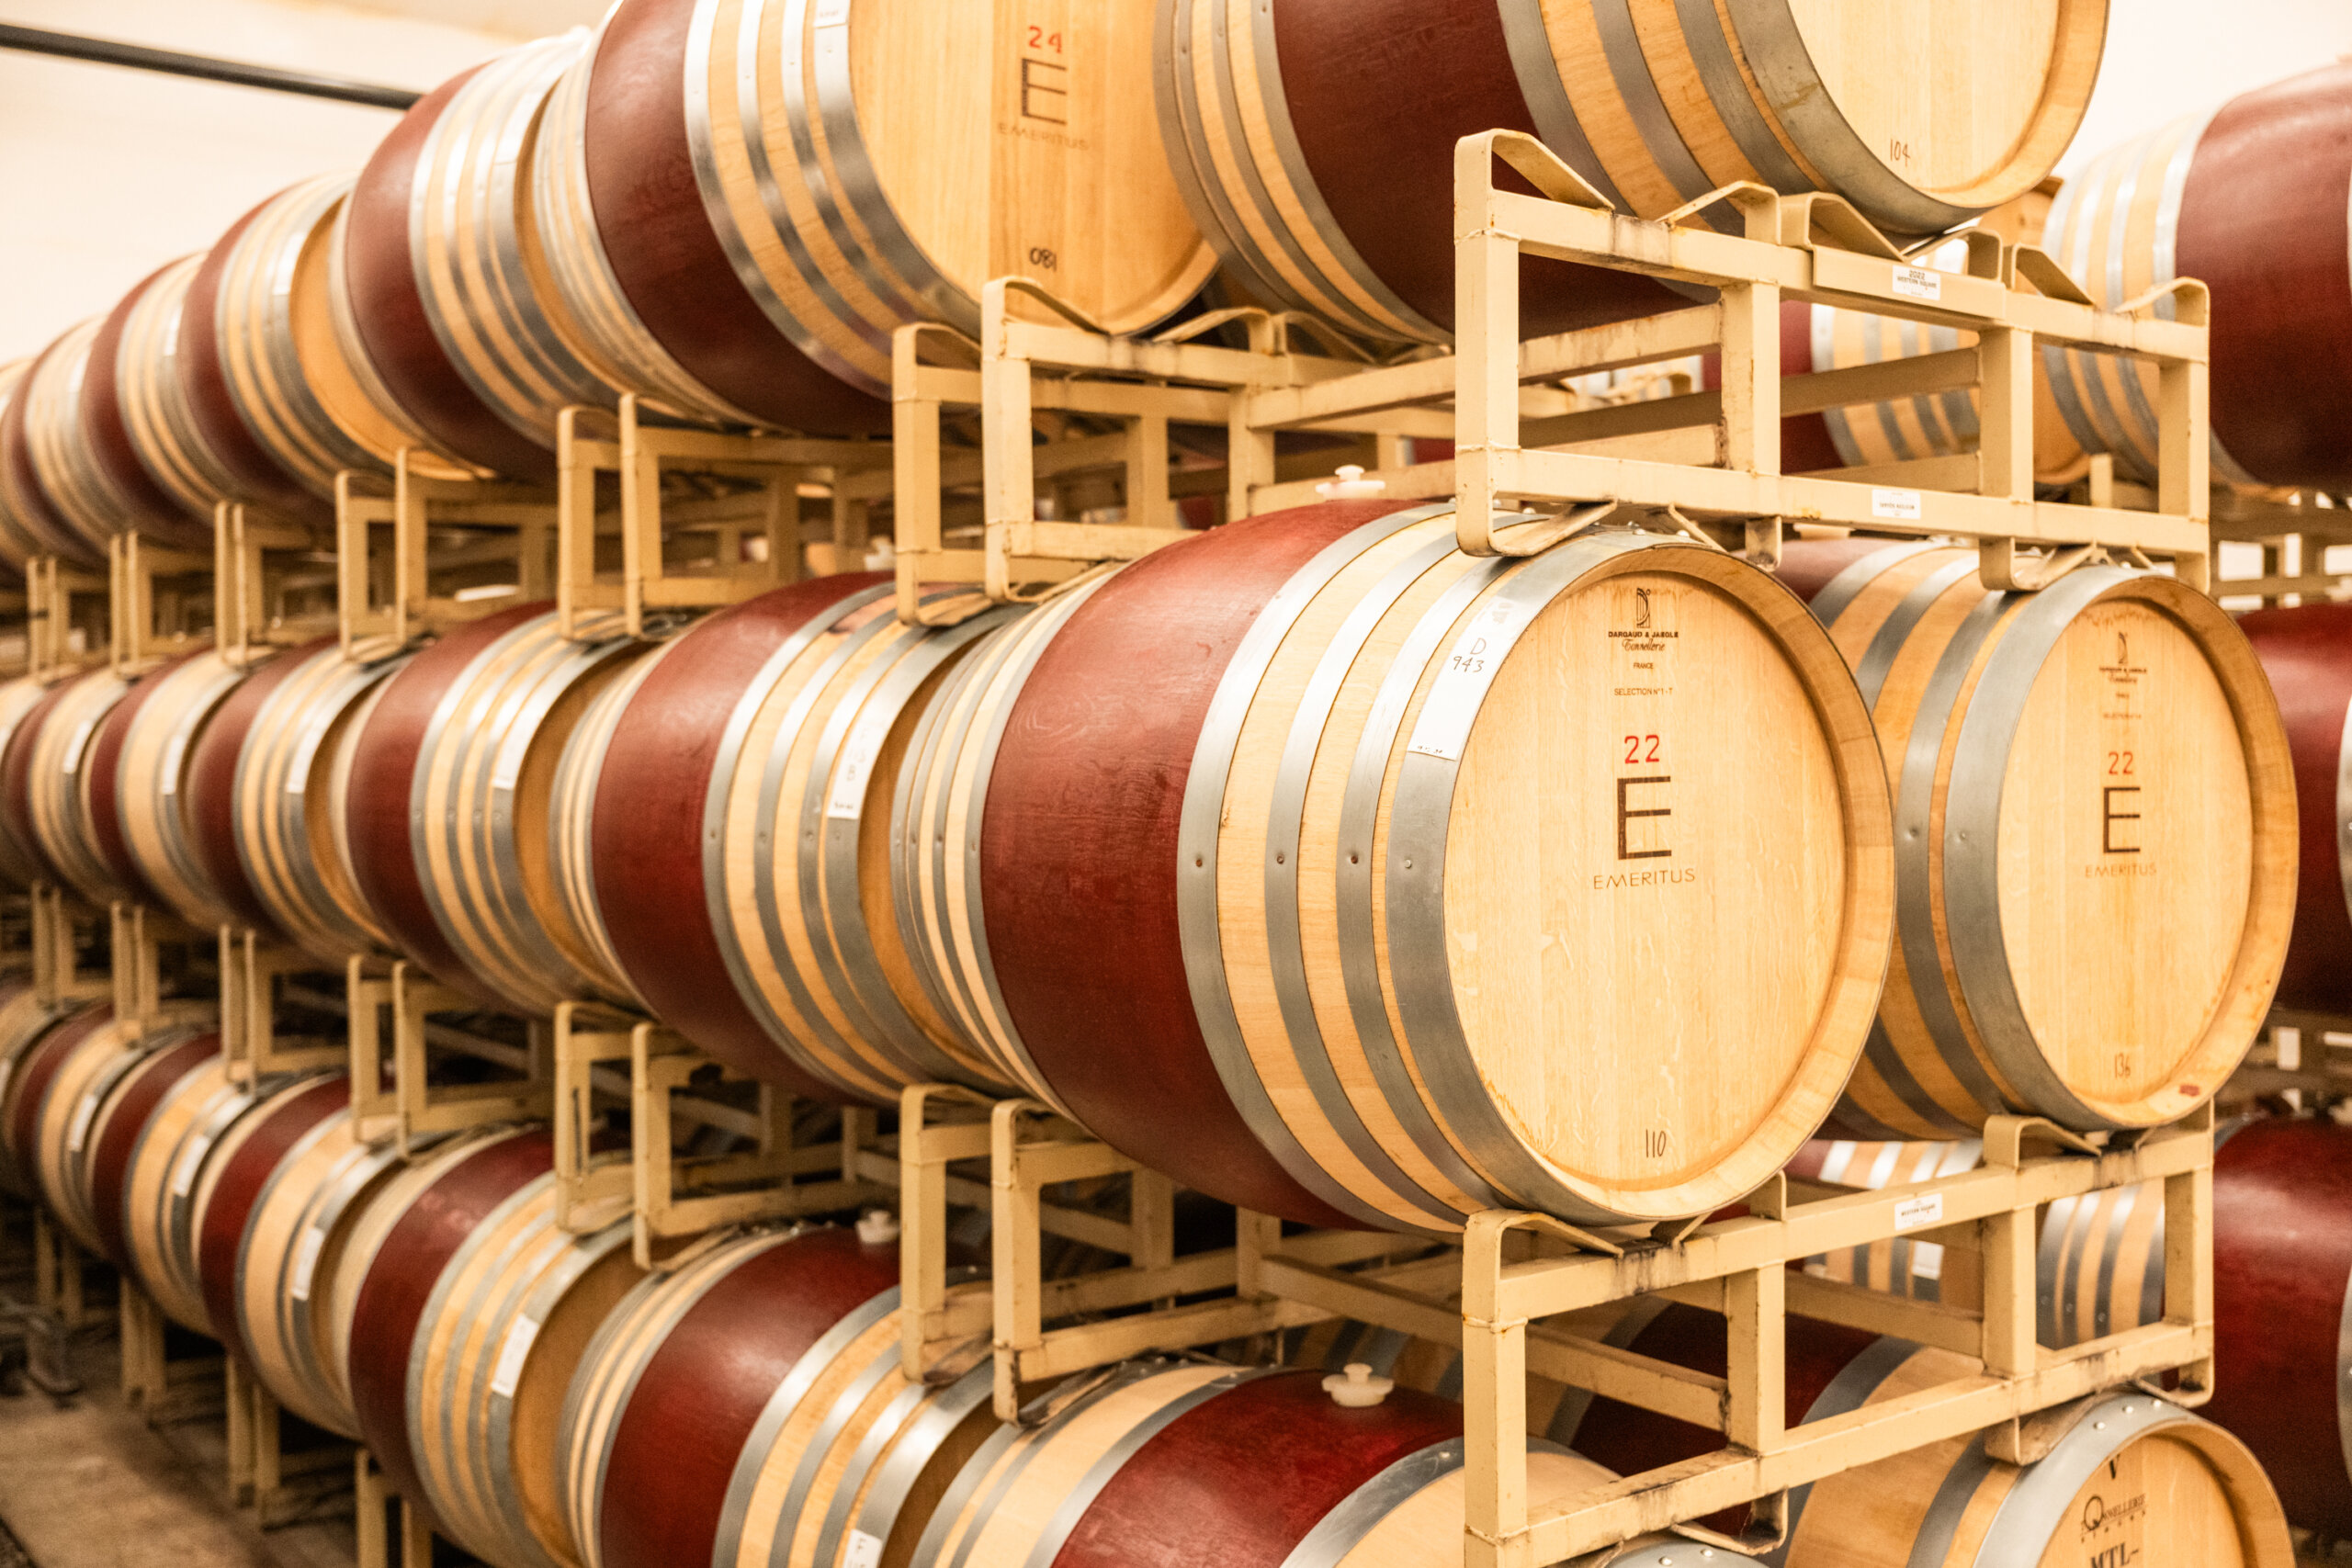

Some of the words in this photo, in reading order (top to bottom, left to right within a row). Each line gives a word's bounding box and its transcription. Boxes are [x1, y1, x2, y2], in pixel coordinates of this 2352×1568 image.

[1028, 25, 1062, 53] 24
[1022, 57, 1068, 126] E
[1890, 138, 1911, 167] 104
[1029, 247, 1057, 273] 081
[1470, 637, 1487, 655] D
[1453, 656, 1485, 672] 943
[1614, 688, 1652, 696] SELECTION
[1624, 734, 1660, 764] 22
[2109, 750, 2133, 775] 22
[1617, 775, 1672, 860] E
[2103, 786, 2141, 853] E
[1593, 867, 1696, 890] EMERITUS
[2085, 862, 2157, 878] EMERITUS
[2114, 1052, 2132, 1079] 136
[1645, 1129, 1667, 1158] 110
